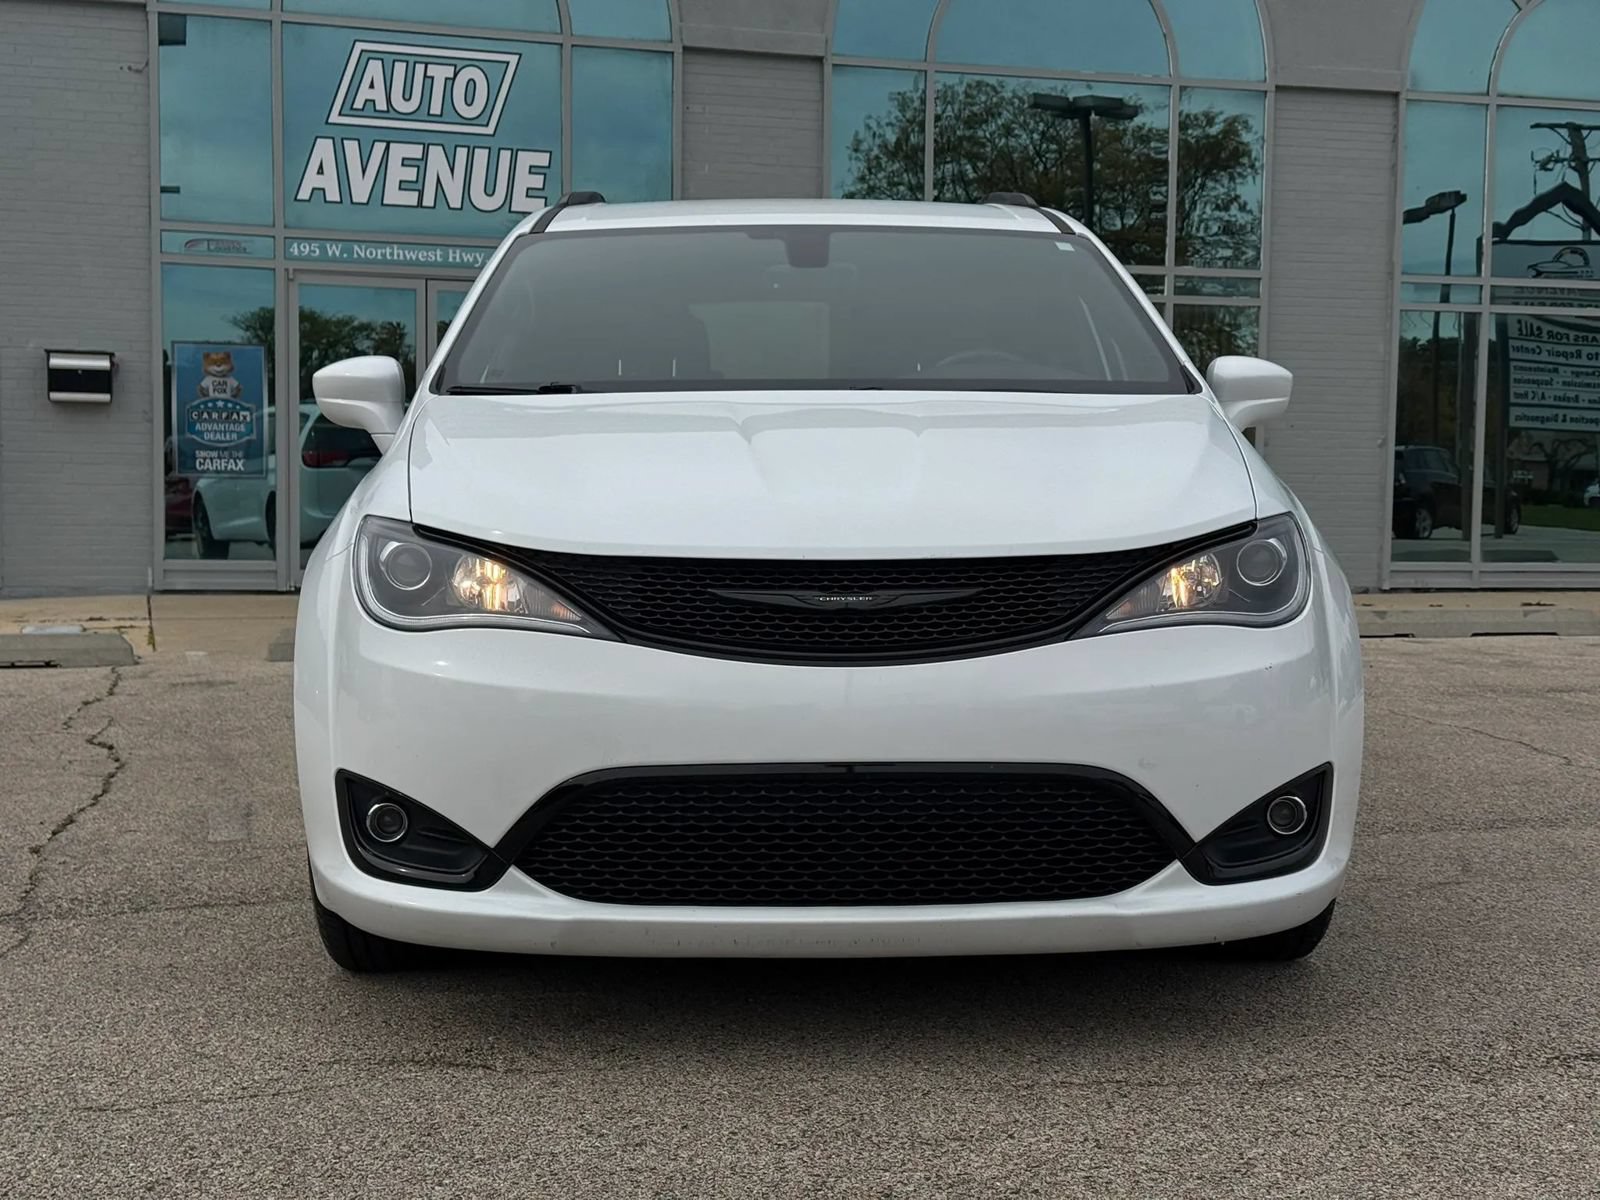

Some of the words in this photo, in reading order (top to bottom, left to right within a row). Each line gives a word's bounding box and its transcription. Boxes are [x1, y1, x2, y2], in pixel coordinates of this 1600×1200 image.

[351, 57, 489, 120] AUTO
[294, 136, 552, 213] AVENUE
[289, 242, 320, 256] 495
[326, 243, 347, 258] W.
[353, 245, 443, 262] Northwest
[191, 410, 251, 422] CARFAX
[195, 422, 246, 432] ADVANTAGE
[204, 432, 237, 441] DEALER
[195, 450, 218, 458] SHOW
[195, 458, 245, 471] CARFAX
